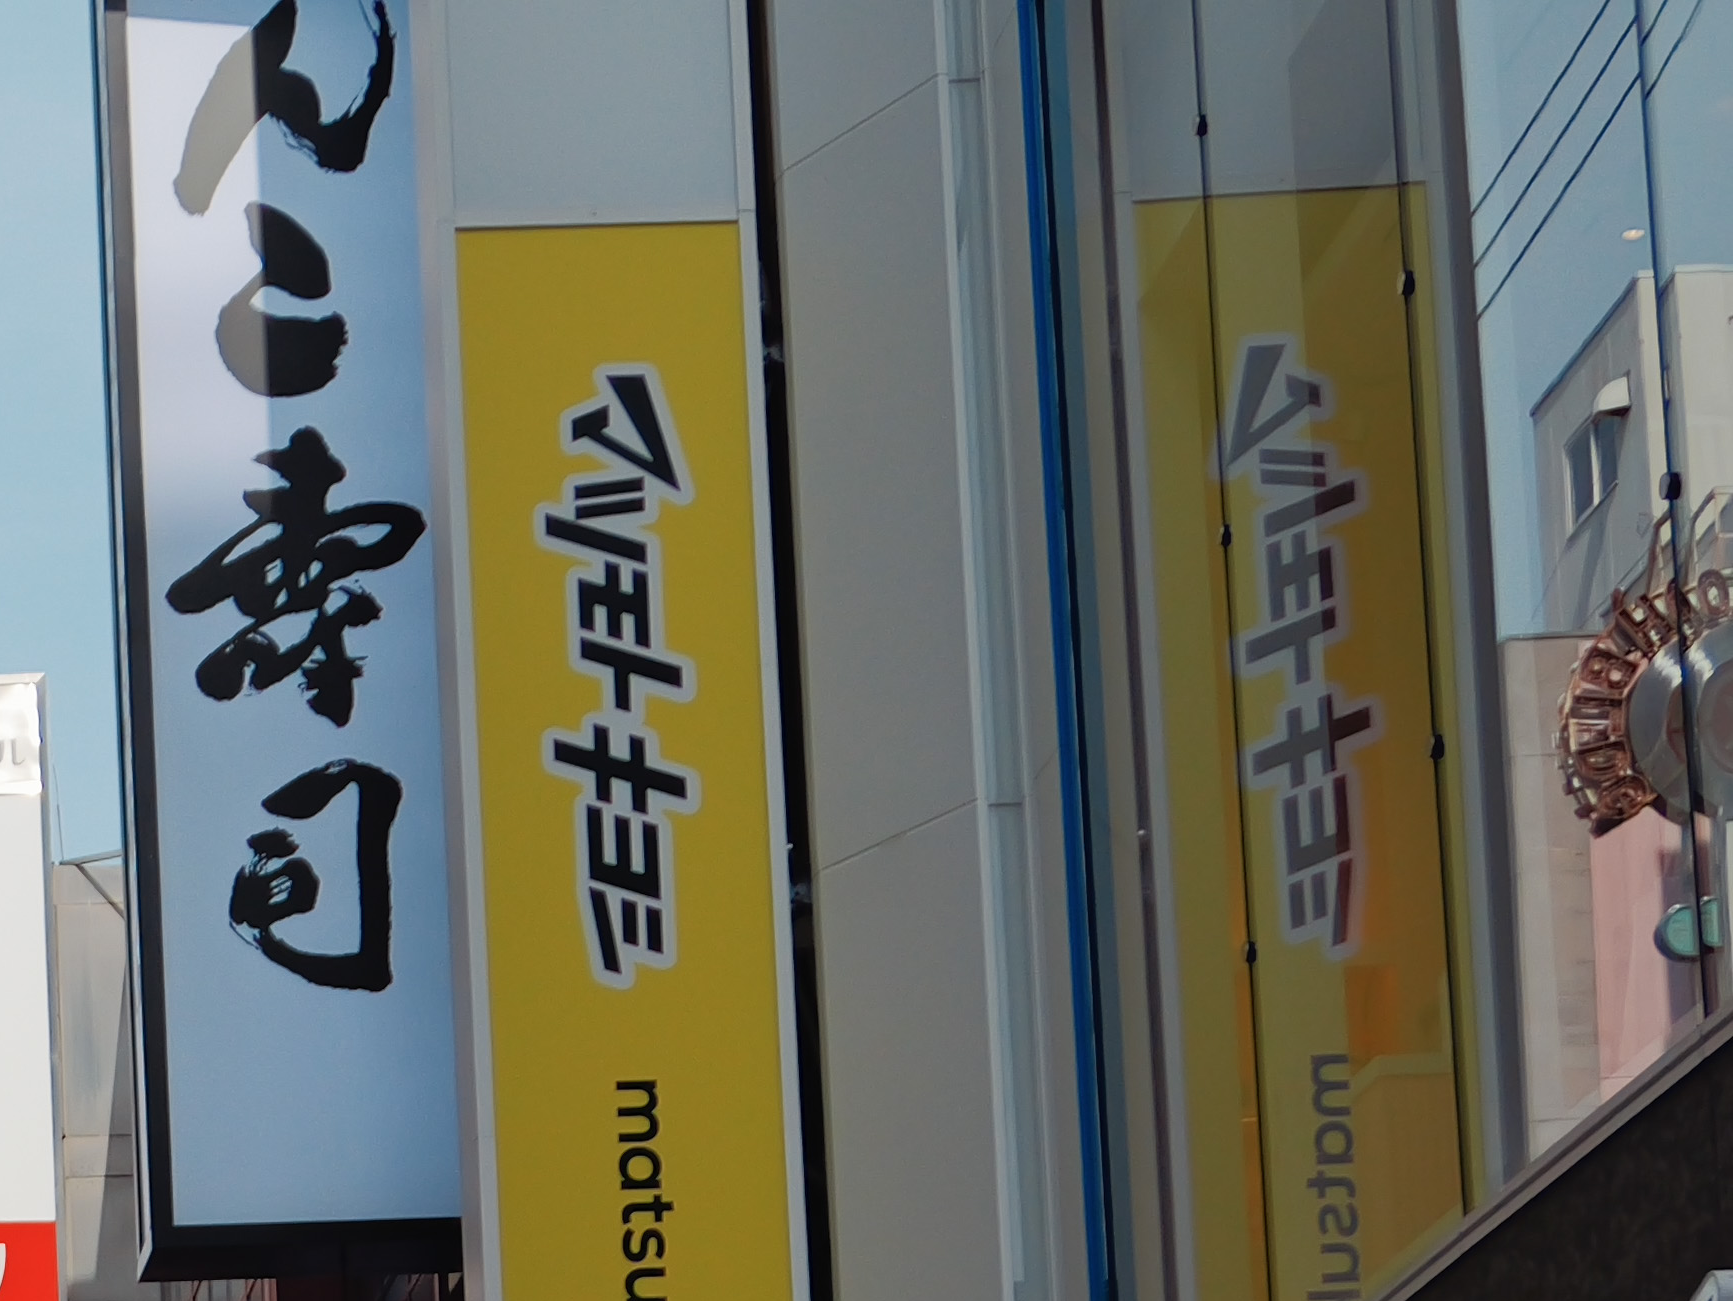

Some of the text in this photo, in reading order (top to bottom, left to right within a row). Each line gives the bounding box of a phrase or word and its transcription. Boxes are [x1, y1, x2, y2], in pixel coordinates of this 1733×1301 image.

[544, 363, 696, 989] マツモトキヨシ
